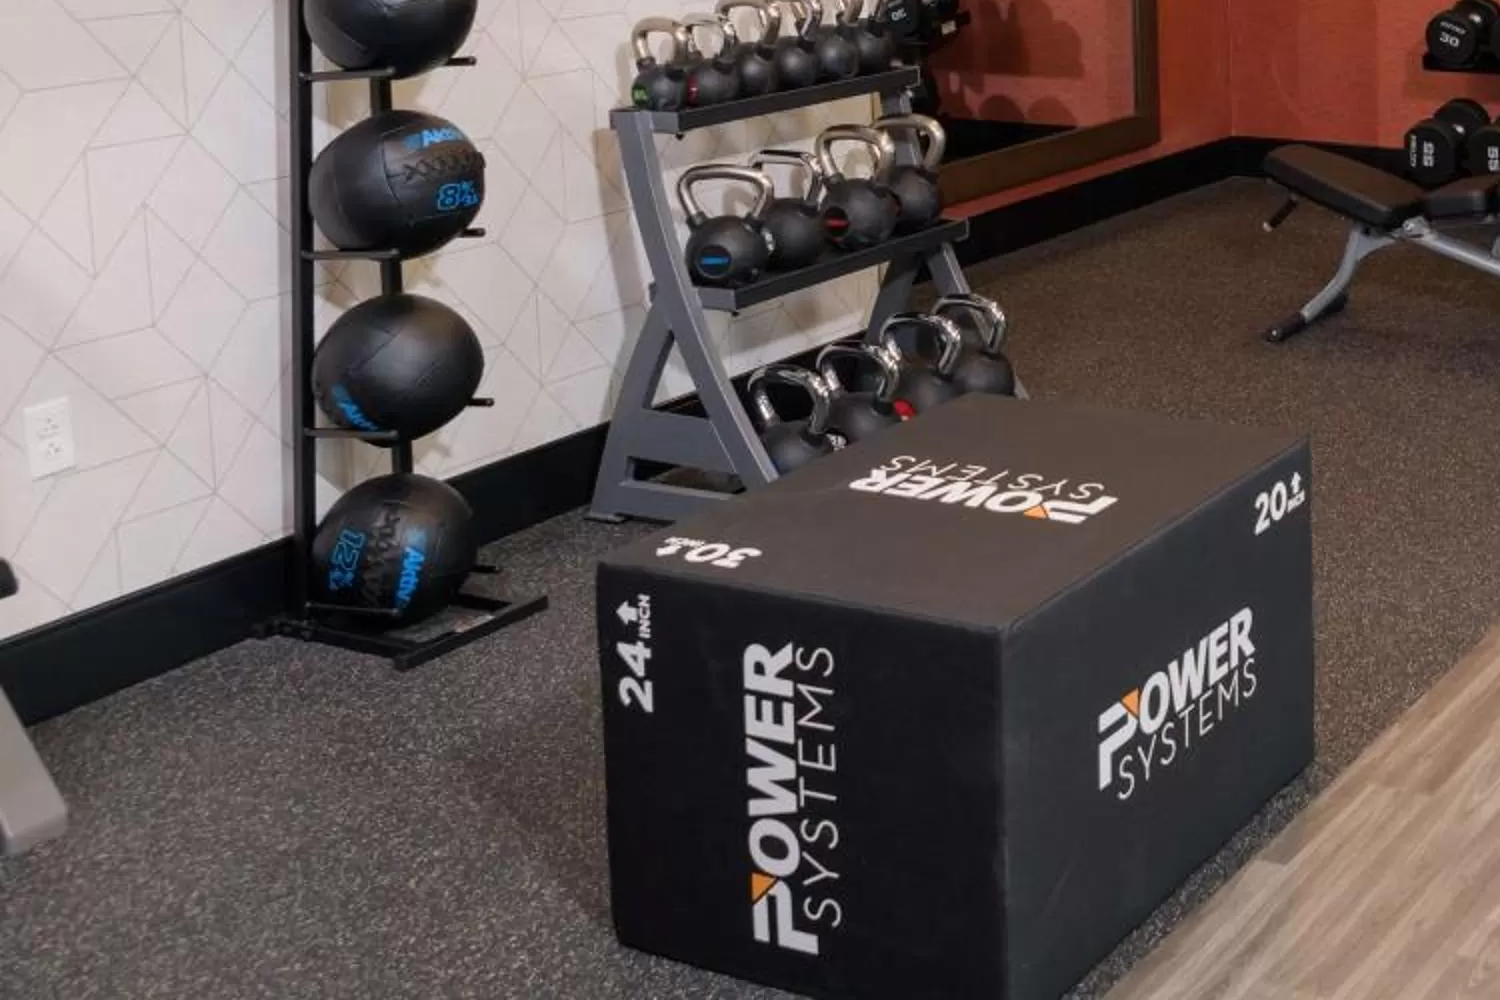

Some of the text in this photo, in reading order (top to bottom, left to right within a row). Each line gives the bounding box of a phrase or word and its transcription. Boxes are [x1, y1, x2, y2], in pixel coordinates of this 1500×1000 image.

[1439, 31, 1460, 48] 30
[849, 468, 1119, 524] POWER
[880, 455, 1105, 499] SYSTEMS
[1255, 480, 1287, 536] 20
[684, 543, 762, 568] 30
[637, 593, 652, 639] INCH
[617, 641, 654, 713] 24
[1099, 606, 1256, 791] POWER
[1117, 657, 1258, 801] SYSTEMS
[743, 641, 820, 955] POWER
[796, 646, 842, 928] SYSTEMS
